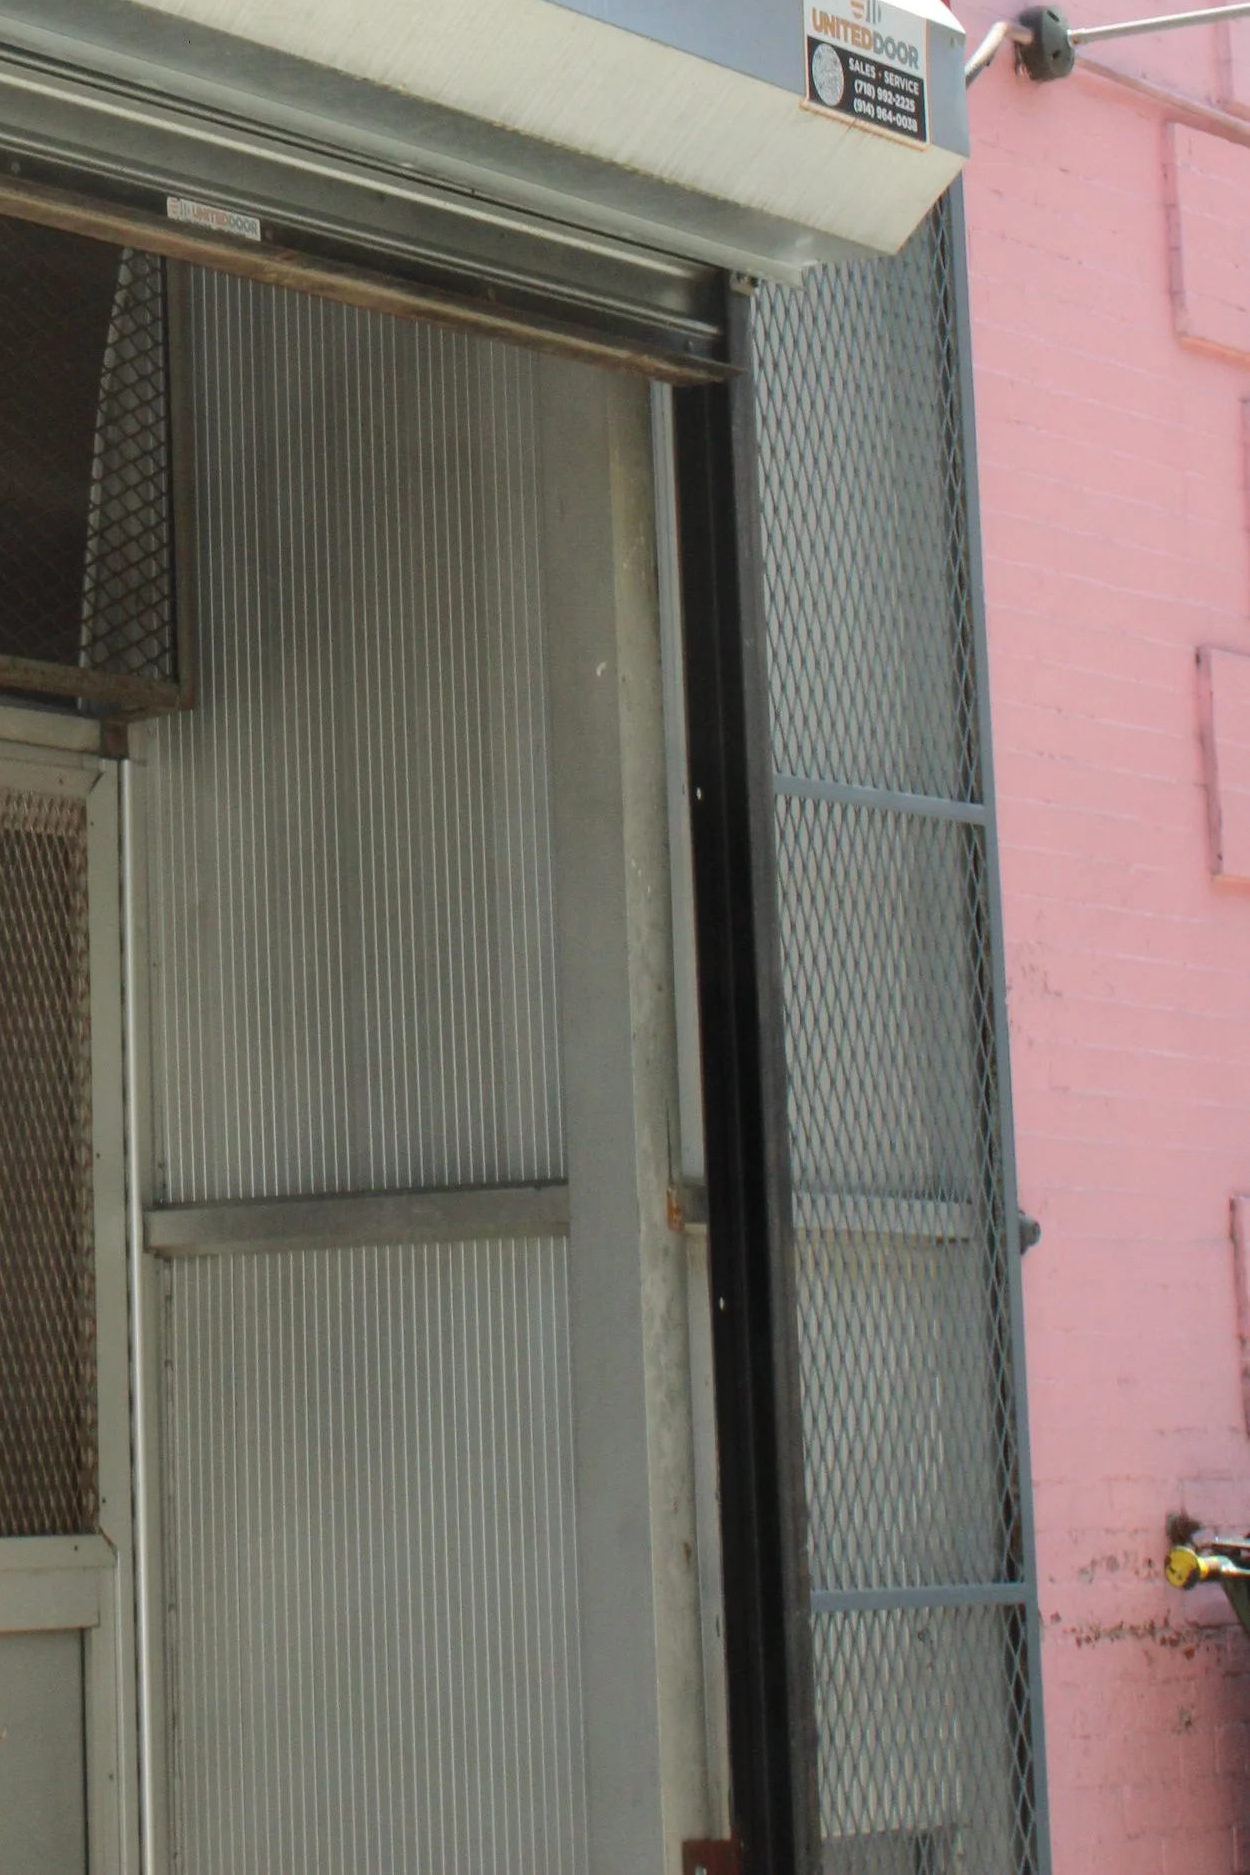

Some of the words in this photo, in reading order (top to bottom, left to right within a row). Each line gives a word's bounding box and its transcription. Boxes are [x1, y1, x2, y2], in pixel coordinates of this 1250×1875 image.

[848, 56, 876, 79] SALES
[883, 69, 919, 96] SERVICE
[854, 78, 876, 100] (718)
[853, 97, 875, 119] (914)
